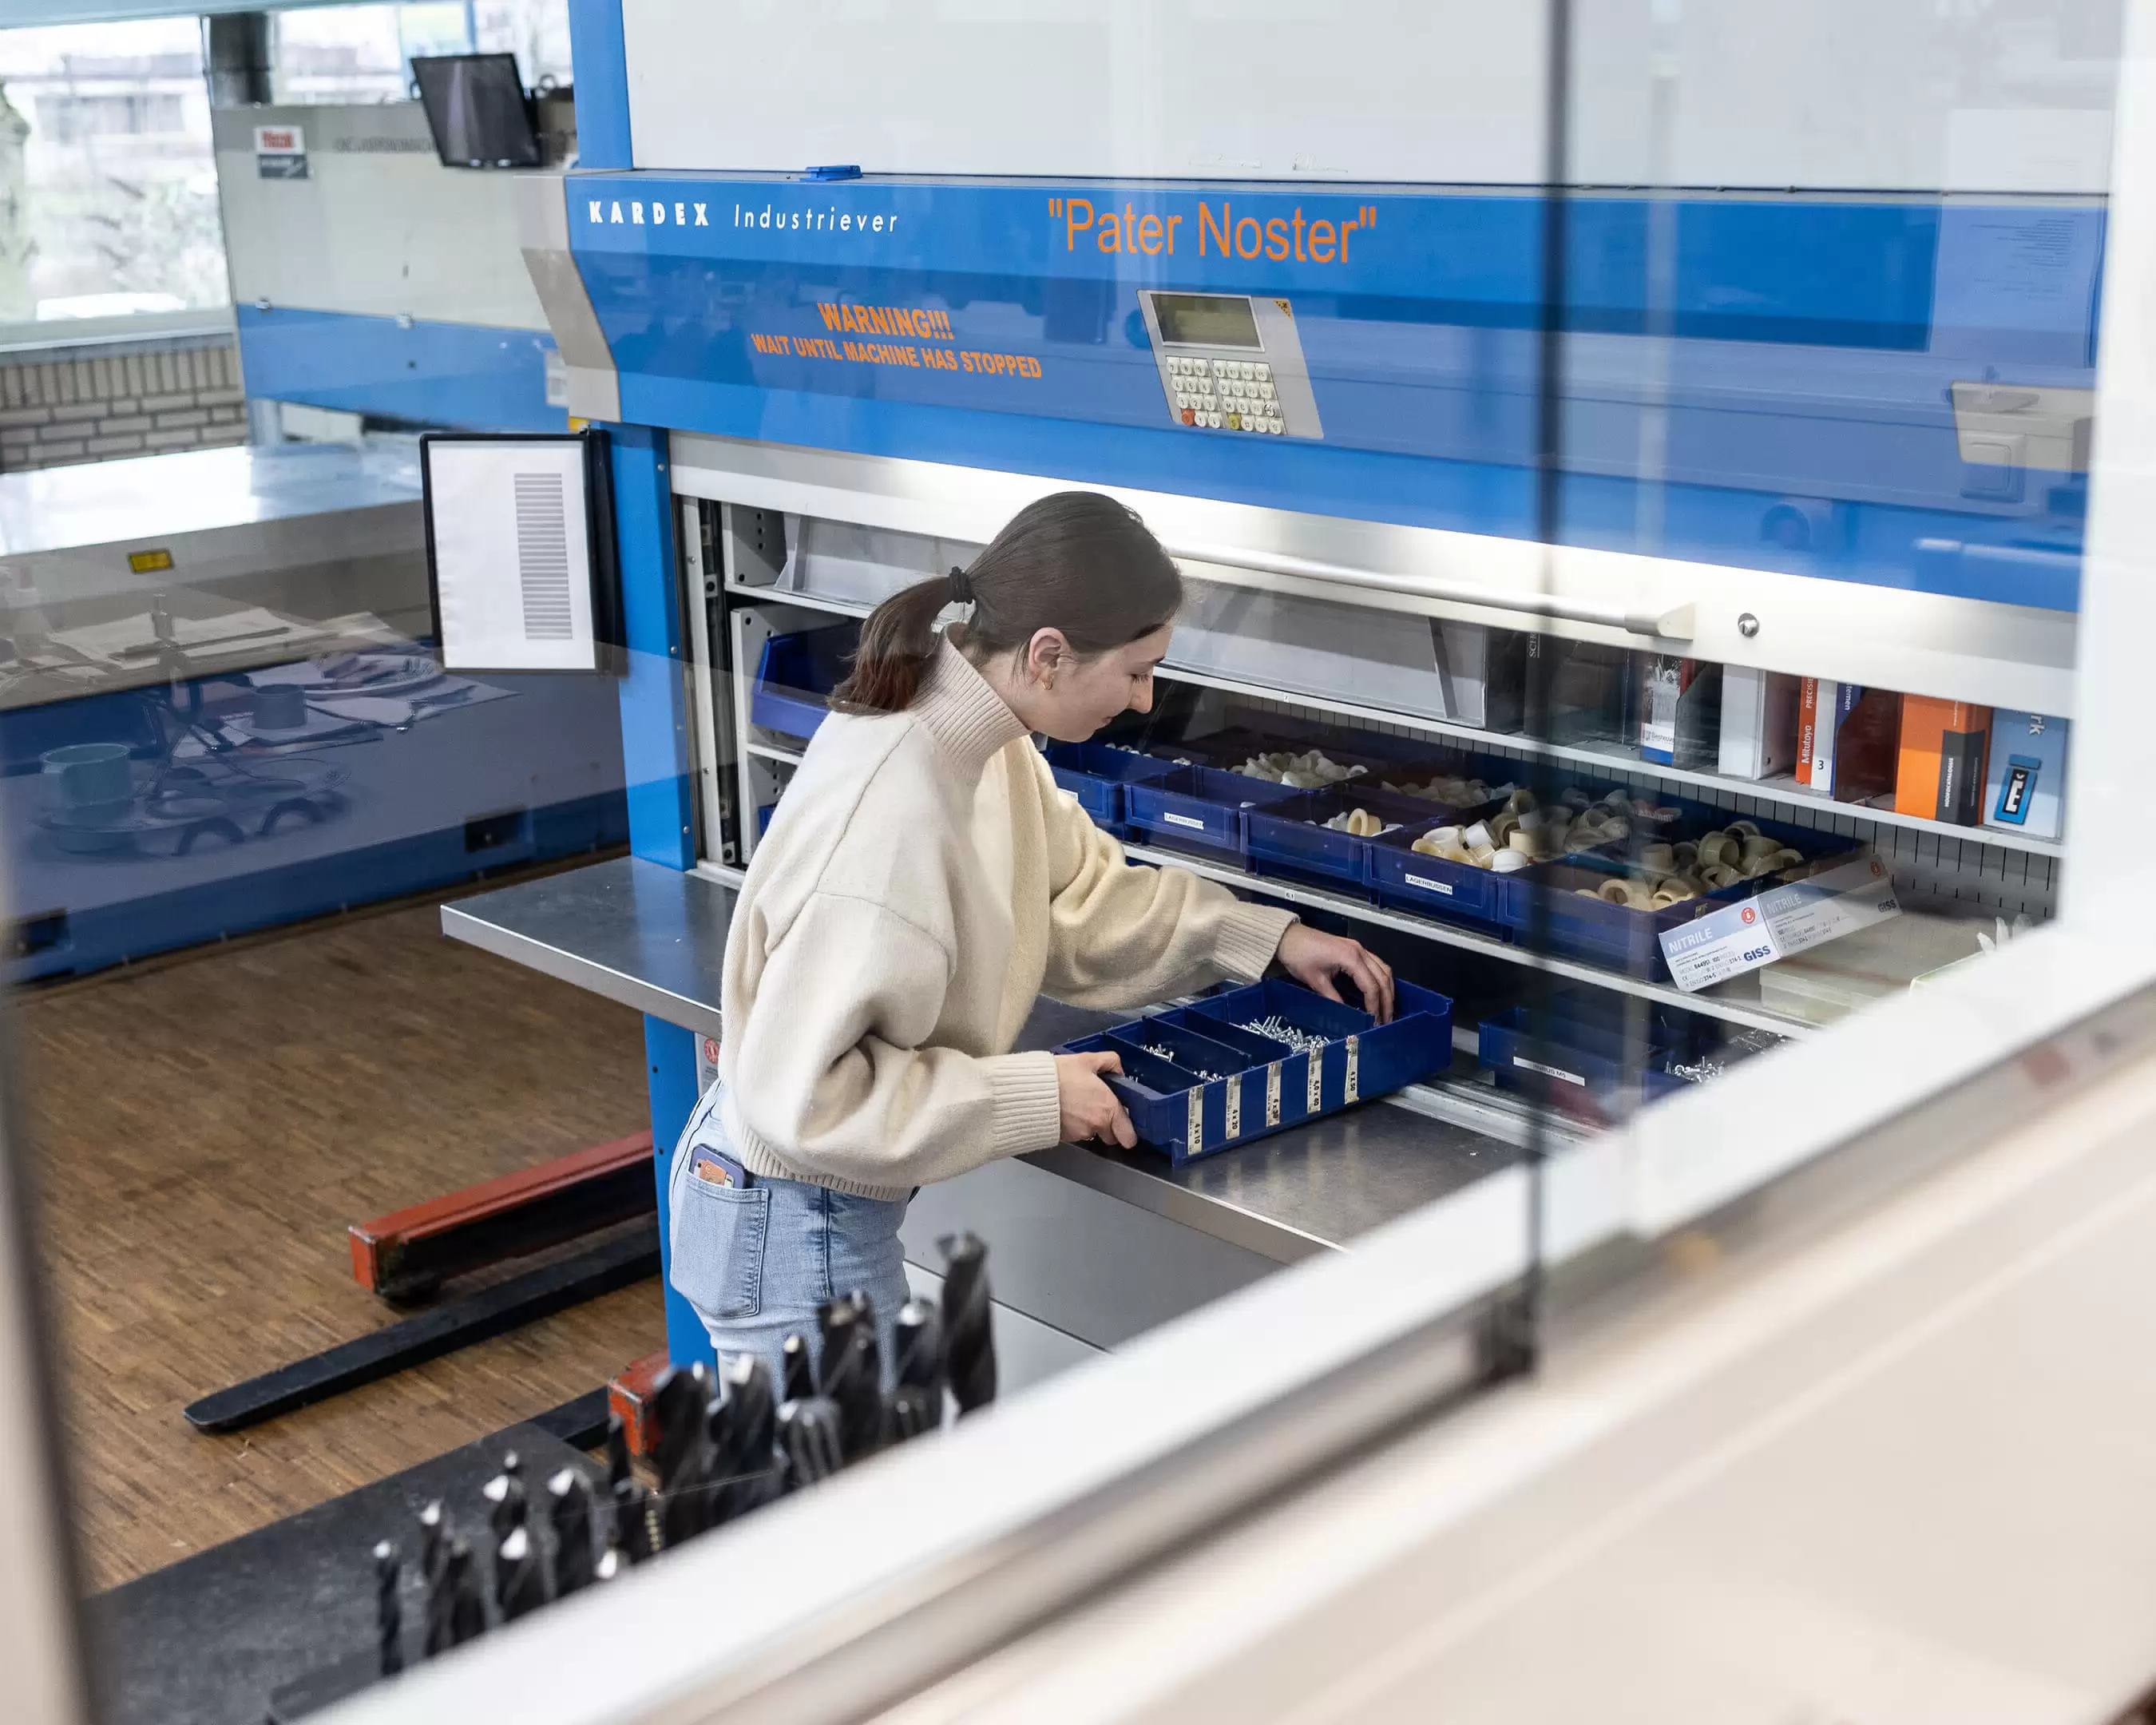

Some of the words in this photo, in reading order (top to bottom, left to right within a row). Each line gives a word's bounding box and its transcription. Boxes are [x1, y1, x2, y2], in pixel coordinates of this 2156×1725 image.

[589, 201, 709, 227] KARDEX
[735, 204, 898, 232] Industriever
[1048, 198, 1183, 255] "Pater
[1198, 202, 1377, 263] Noster"
[818, 302, 954, 340] WARNING!!!
[751, 333, 789, 355] WAIT
[793, 336, 842, 360] UNTIL
[842, 341, 920, 367] MACHINE
[921, 347, 957, 371] HAS
[960, 351, 1042, 378] STOPPED
[1801, 724, 1813, 764] Mitutoyo
[1817, 759, 1825, 771] 3
[1877, 899, 1897, 913] GISS
[1743, 945, 1771, 962] GISS
[1231, 1120, 1239, 1130] 20
[1194, 1135, 1201, 1144] 10
